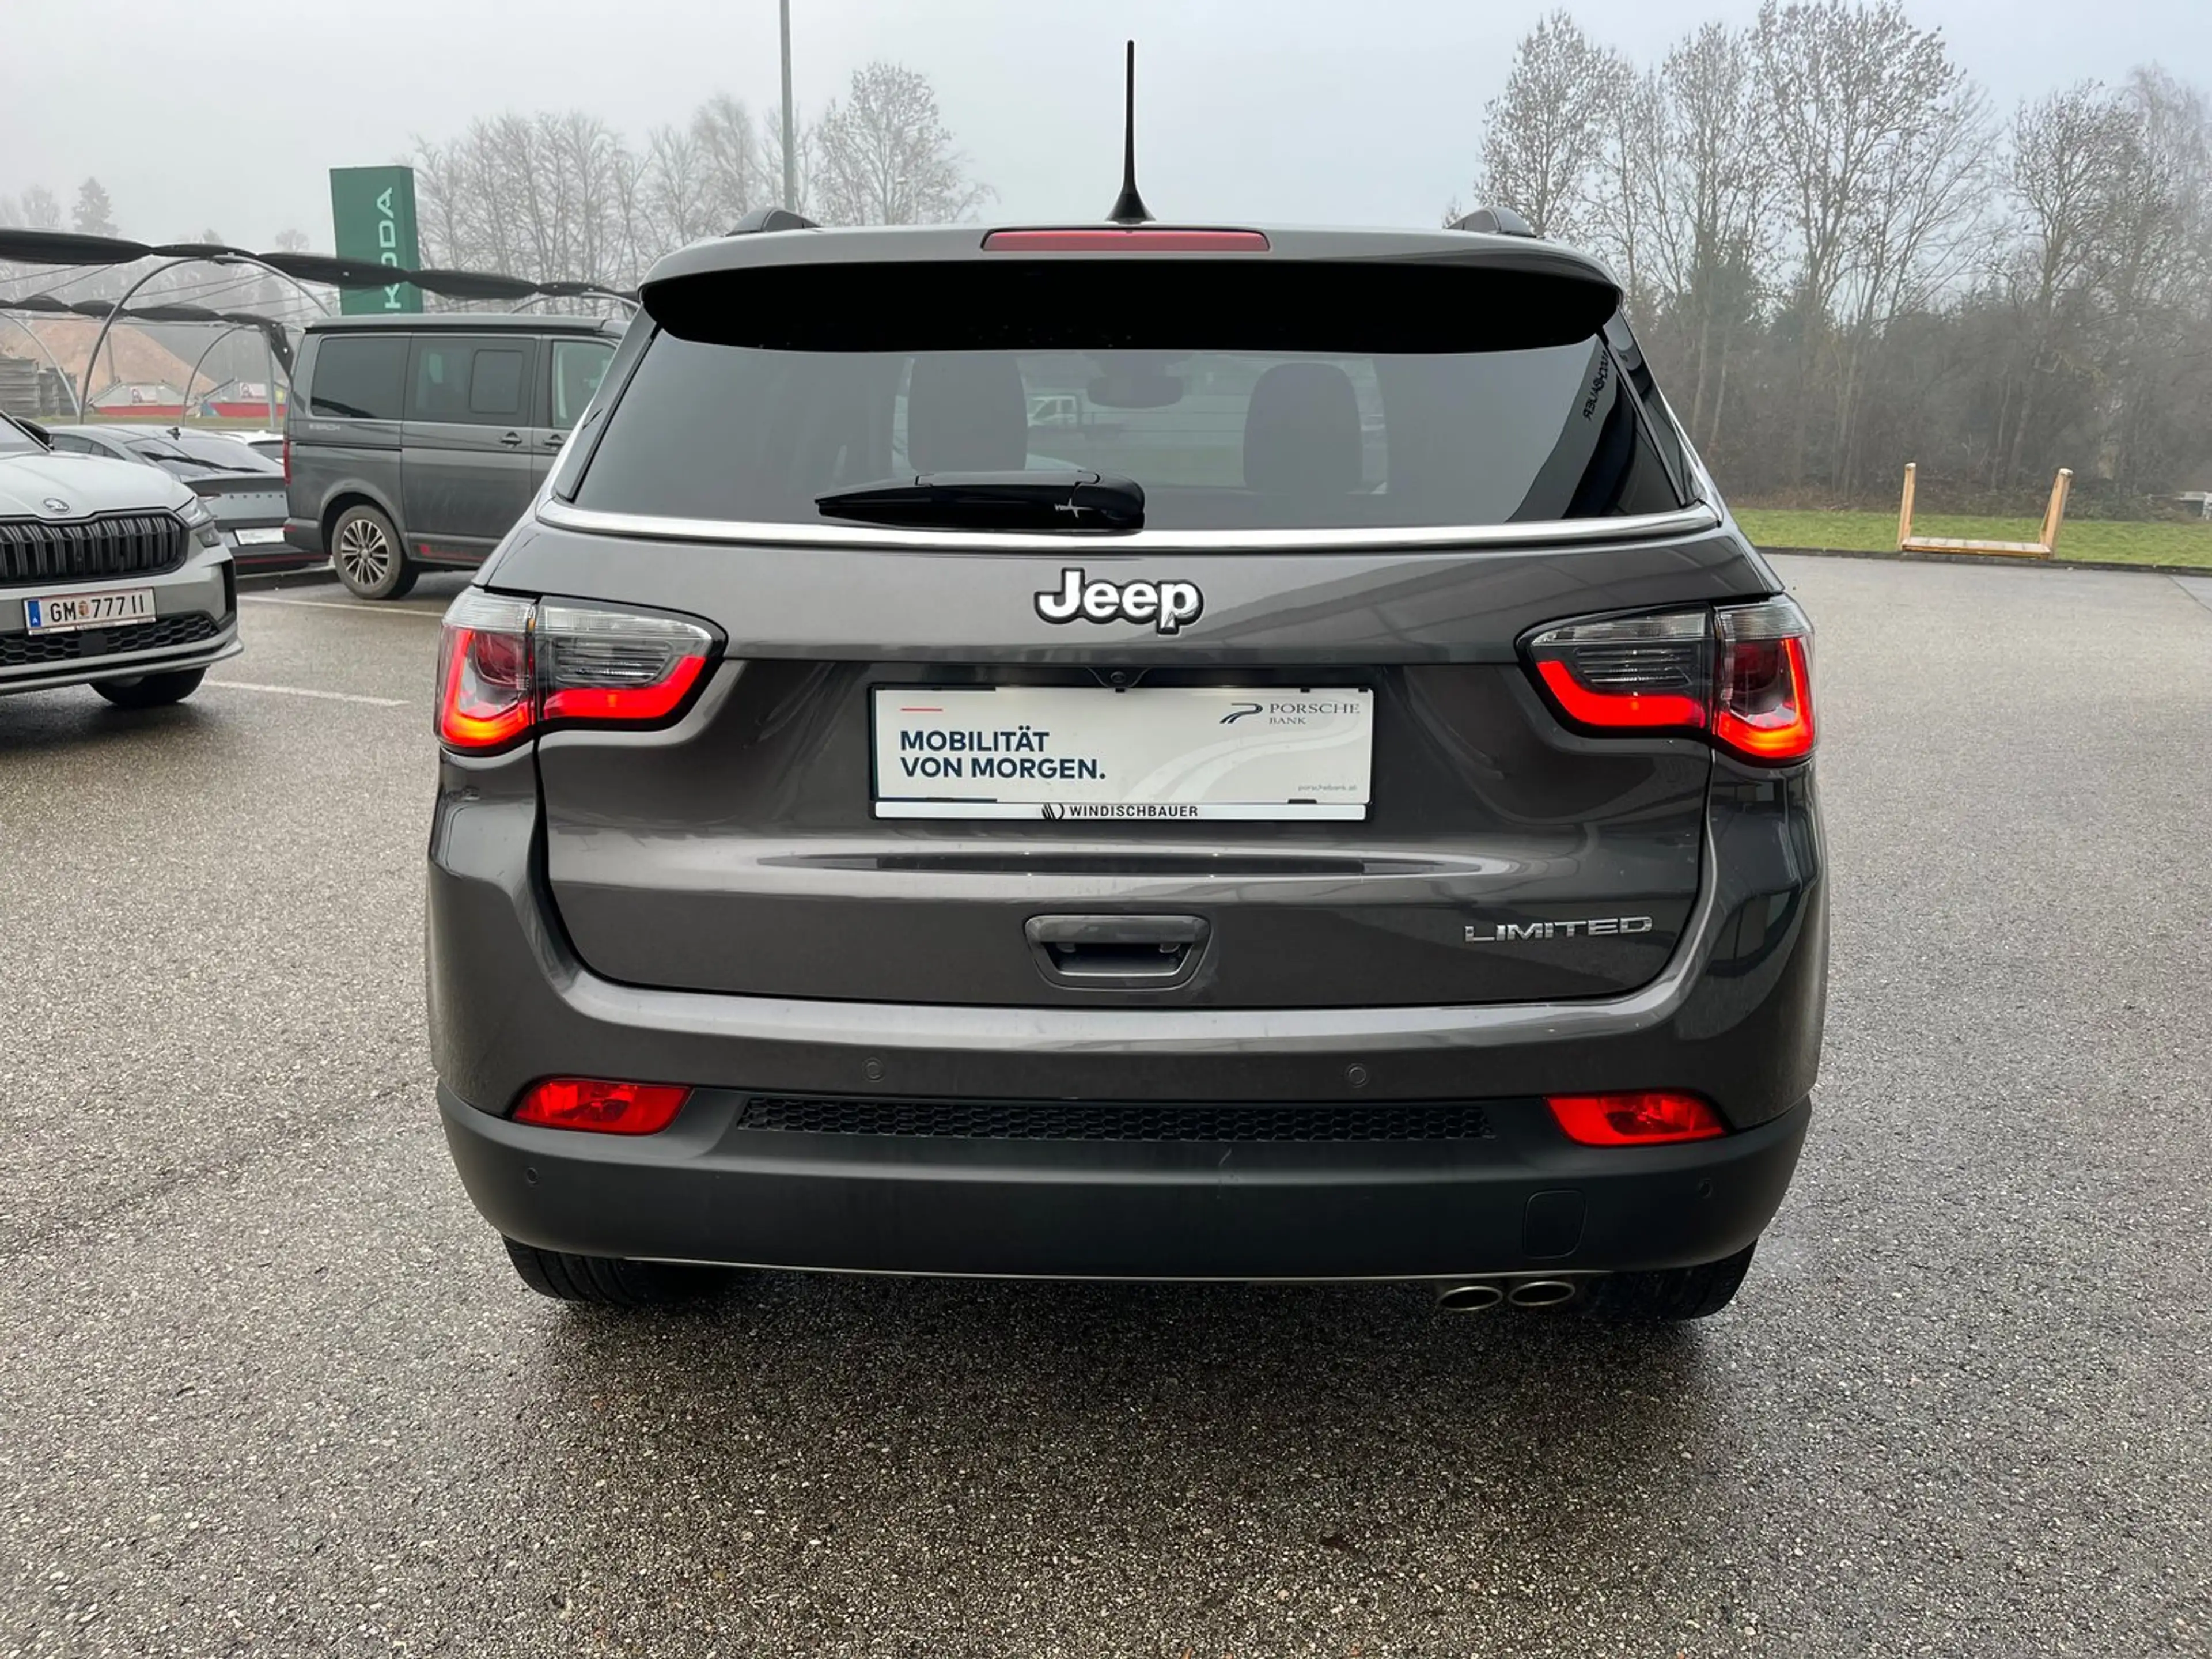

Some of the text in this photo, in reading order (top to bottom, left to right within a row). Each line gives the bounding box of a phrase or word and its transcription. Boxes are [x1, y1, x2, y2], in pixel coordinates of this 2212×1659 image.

[1035, 568, 1202, 633] Jeep
[50, 602, 76, 622] GM
[1269, 703, 1361, 714] PORSCHE
[1269, 717, 1306, 725] BANK
[900, 725, 1050, 752] MOBILITÄT
[900, 756, 1106, 779] VON MORGEN.
[1069, 805, 1199, 817] WINDISCHBAUER
[1464, 916, 1652, 942] LIMITED
